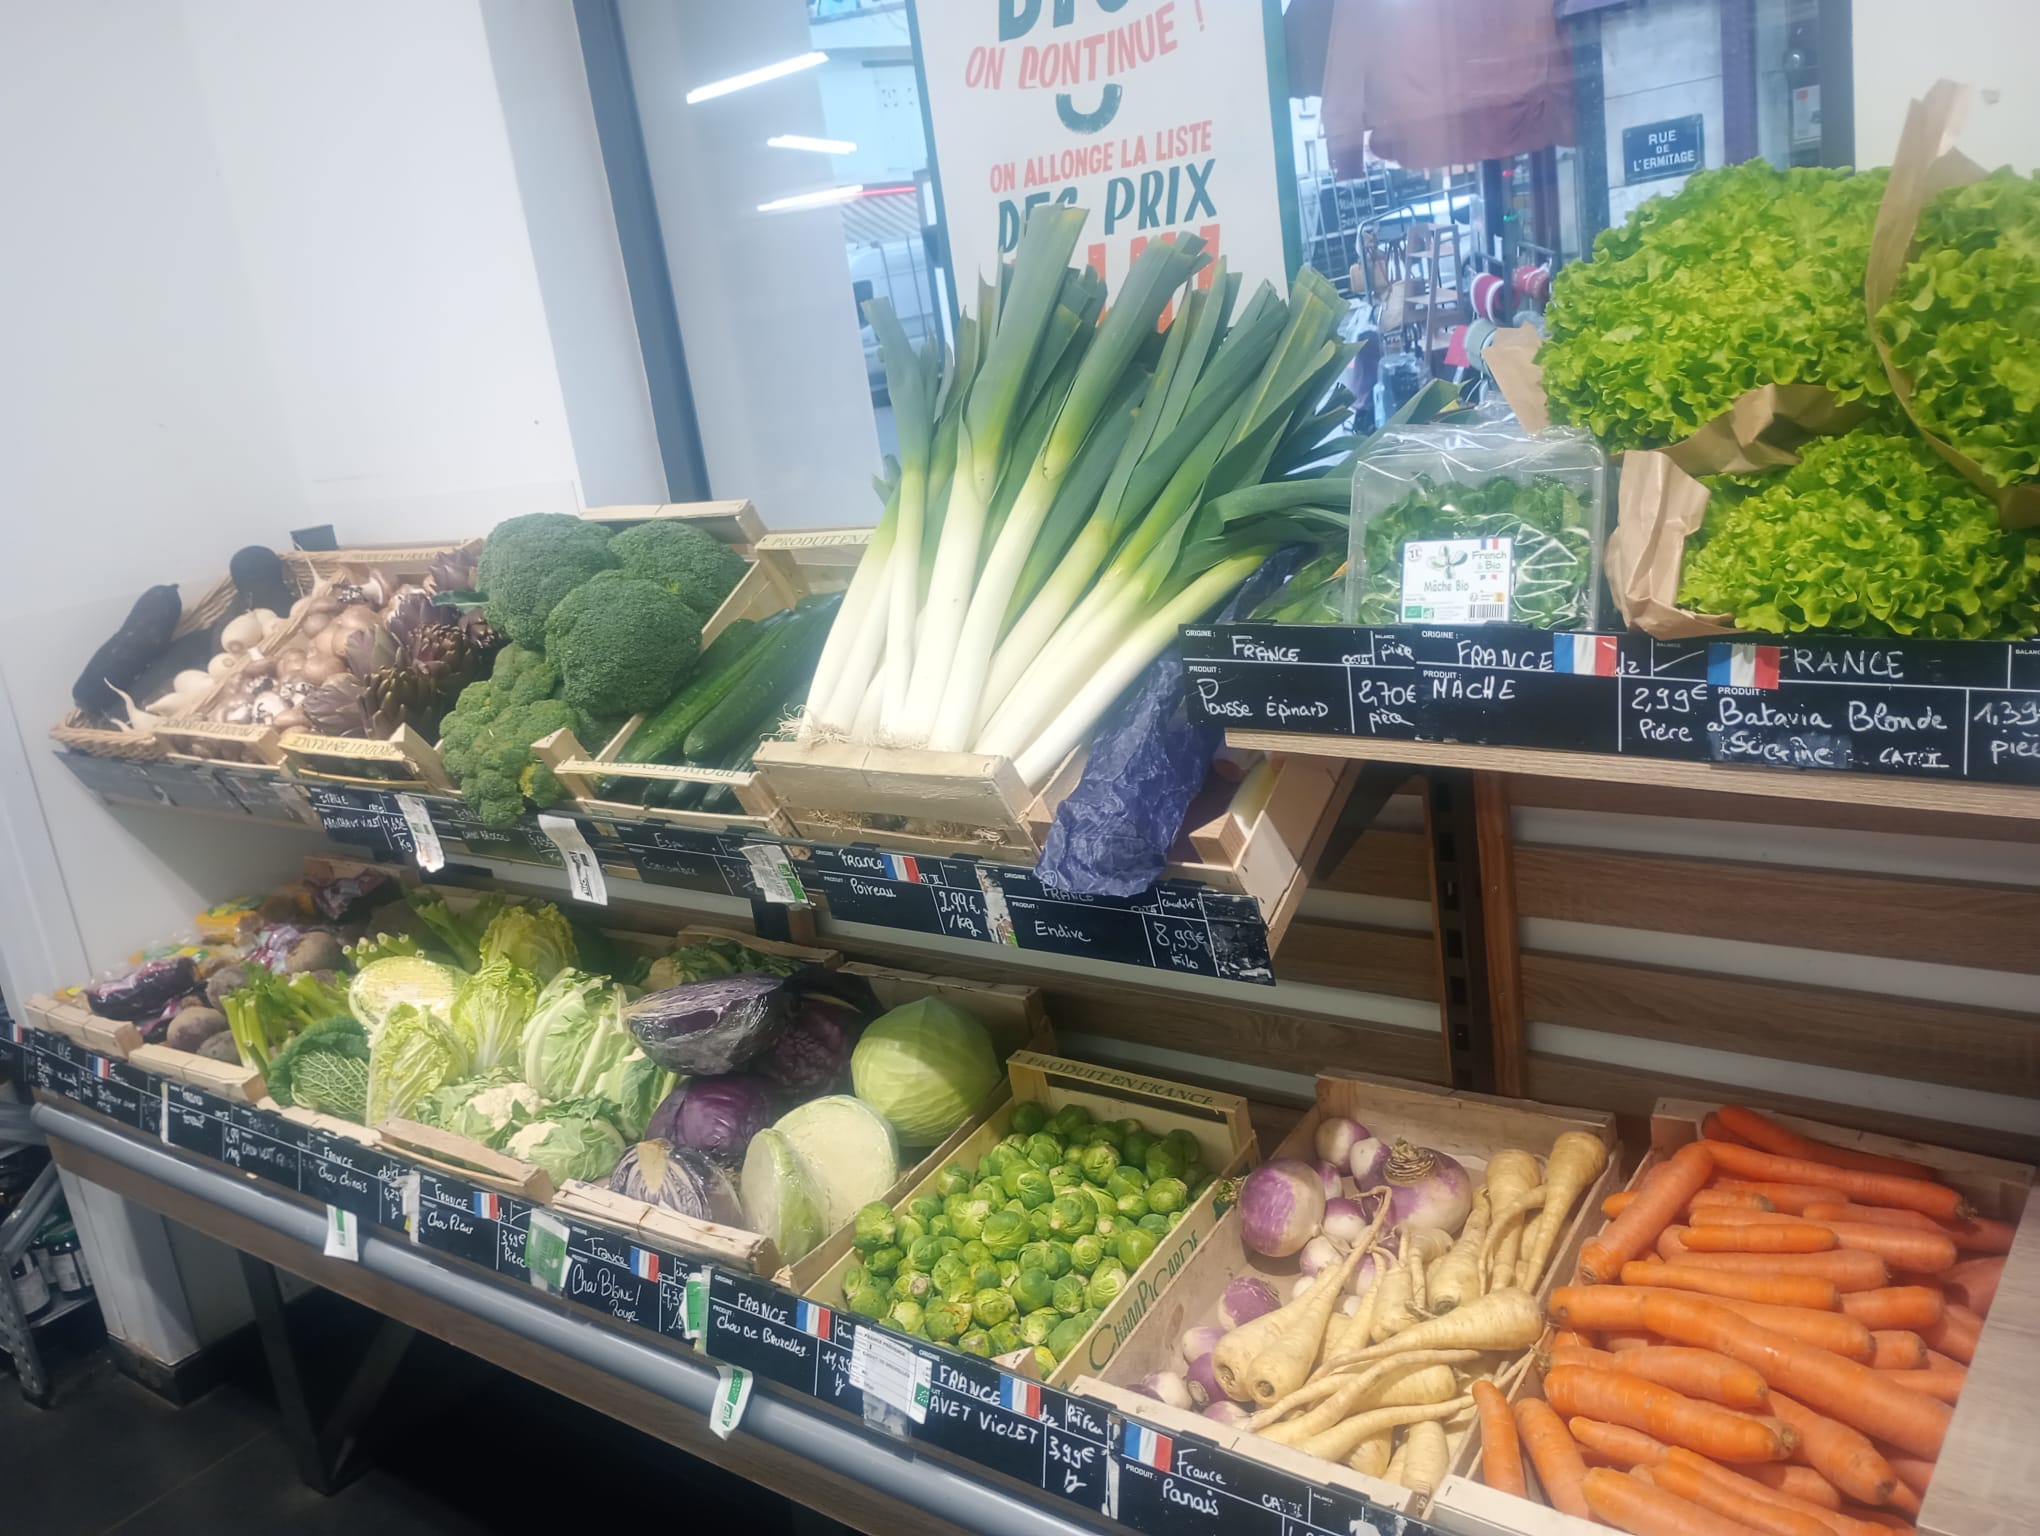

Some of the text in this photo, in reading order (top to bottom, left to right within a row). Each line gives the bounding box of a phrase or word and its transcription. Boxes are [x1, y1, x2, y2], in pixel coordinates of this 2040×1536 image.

[965, 46, 1005, 90] ON
[1648, 130, 1677, 145] RUE
[1656, 144, 1670, 153] DE
[990, 120, 1213, 193] ON ALLONGE LA LISTE
[1633, 151, 1696, 172] L'ERMITAGE
[1104, 159, 1217, 236] PRIX
[1455, 580, 1470, 592] Bio
[1185, 629, 1212, 637] ORIGINE
[1421, 630, 1455, 640] ORIGINE
[1231, 635, 1301, 662] FRANCE
[1456, 640, 1554, 670] FRANCE
[1188, 665, 1217, 674] PRODUIT
[1422, 669, 1458, 680] PRODUIT
[1433, 675, 1517, 700] MACHE
[1631, 683, 1709, 713] 2,99€
[1717, 687, 1761, 697] PRODUIT
[1719, 697, 1948, 732] Batavia Blonde
[850, 877, 897, 898] Poireau
[1034, 920, 1092, 943] Endive
[1025, 1055, 1214, 1106] PRODUIT EN FRANCE
[434, 1183, 469, 1209] FRANCE
[738, 1292, 789, 1325] FRANCE
[716, 1314, 741, 1334] Chou
[939, 1365, 1001, 1406] FRANCE
[929, 1395, 972, 1422] AVET
[1125, 1463, 1155, 1480] PRODUIT
[1177, 1448, 1228, 1485] France
[1162, 1478, 1220, 1516] Panais
